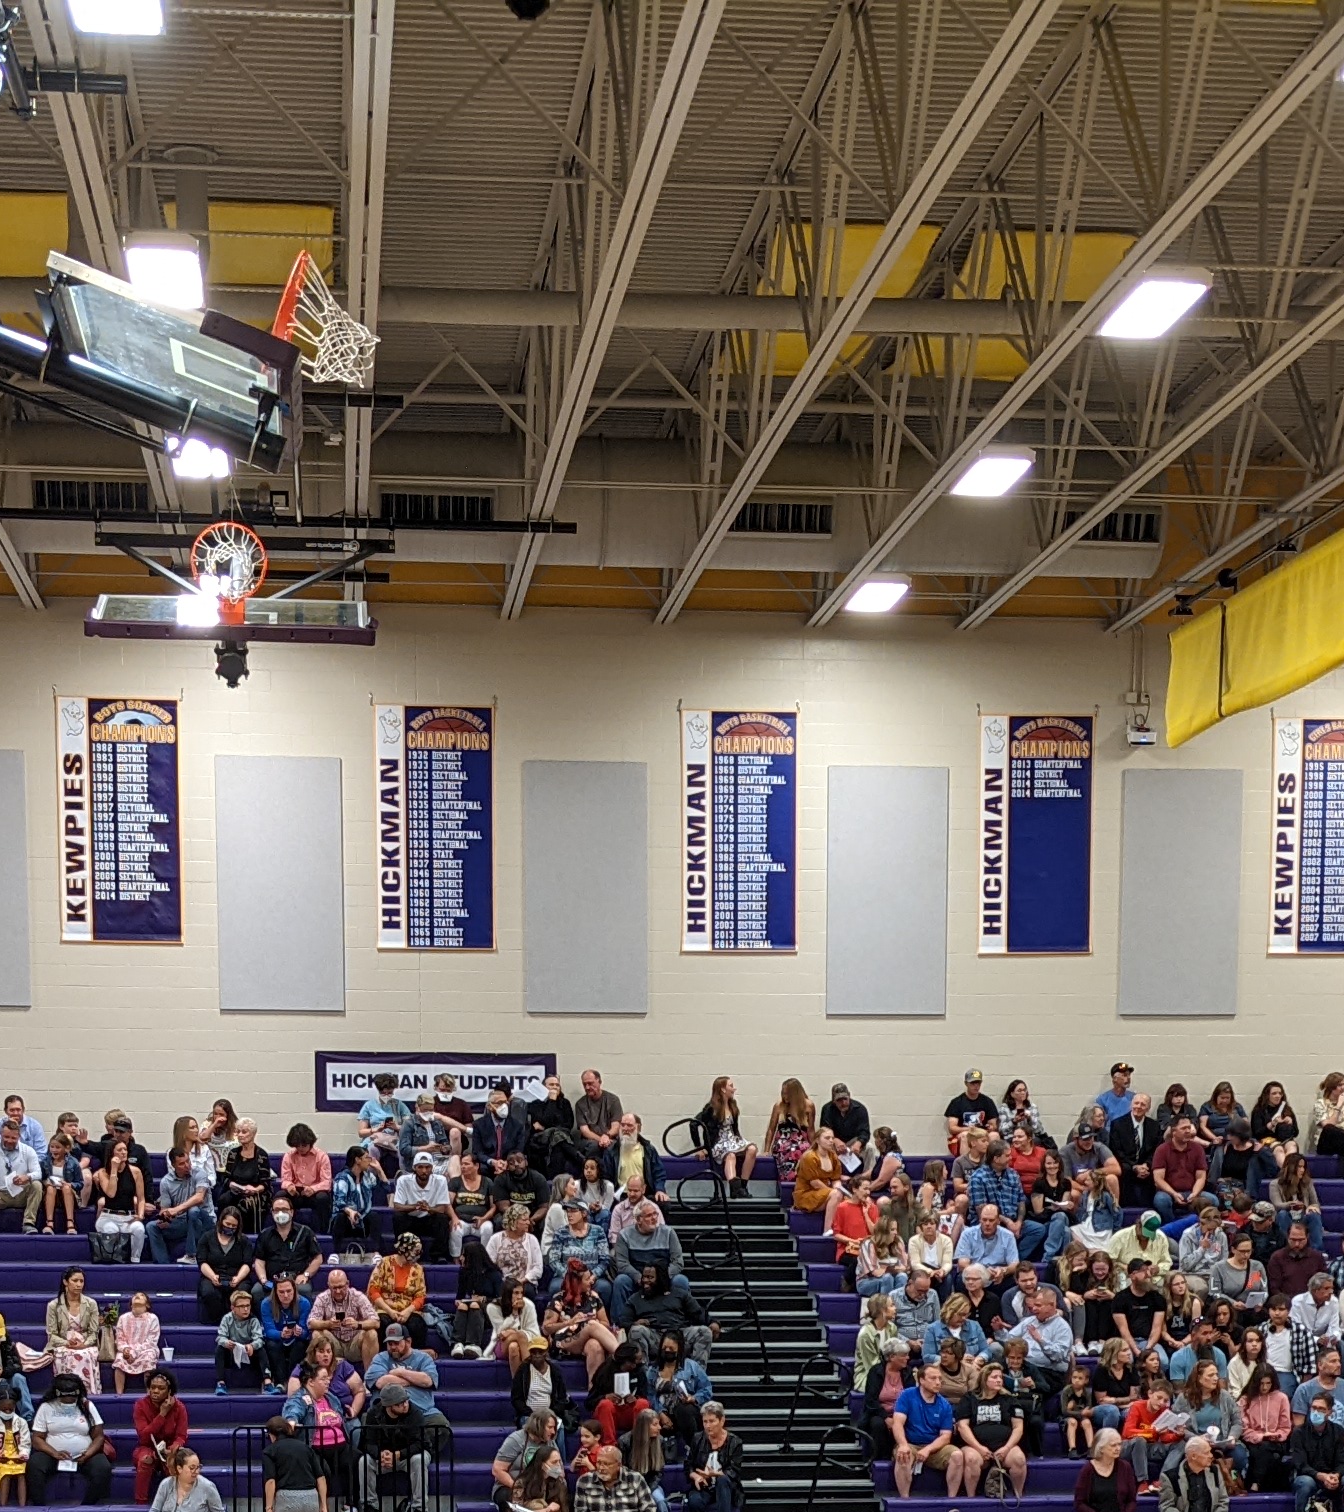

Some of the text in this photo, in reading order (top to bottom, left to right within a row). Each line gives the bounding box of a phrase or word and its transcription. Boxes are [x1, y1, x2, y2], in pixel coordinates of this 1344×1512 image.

[91, 723, 176, 743] CHAMPIONS
[408, 731, 490, 750] CHAMPIONS
[714, 736, 794, 755] CHAMPIONS
[1011, 740, 1090, 758] CHAMPIONS
[63, 753, 87, 922] KEWPIES
[380, 759, 401, 929] HICKMAN
[687, 764, 706, 932] HICKMAN
[983, 768, 1003, 935] HICKMAN
[1274, 773, 1296, 935] KEWPIES
